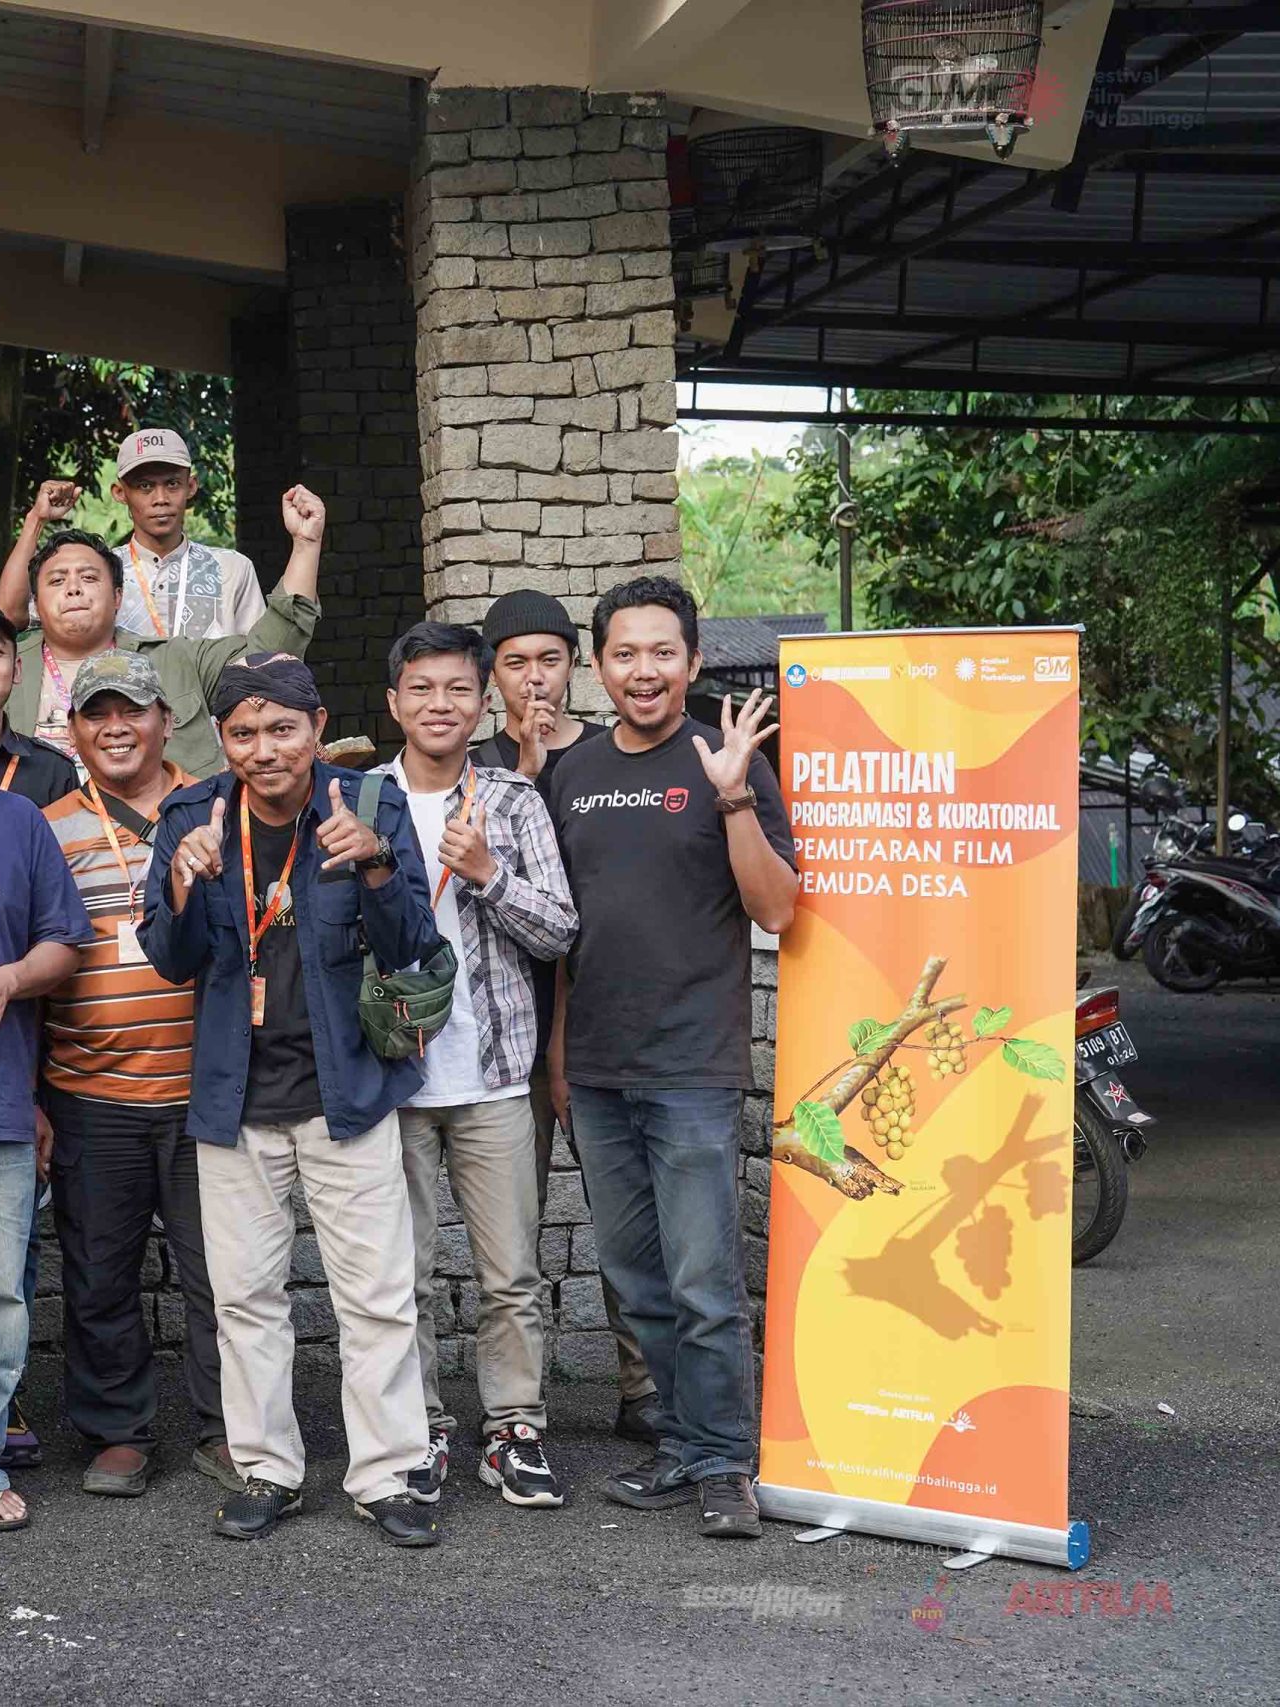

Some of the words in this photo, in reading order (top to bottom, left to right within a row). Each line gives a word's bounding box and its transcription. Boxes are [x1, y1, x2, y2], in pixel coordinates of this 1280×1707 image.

[143, 436, 165, 447] 501
[908, 663, 937, 678] lpdp
[792, 751, 955, 794] PELATIHAN
[570, 788, 663, 814] symbolic
[791, 801, 912, 828] PROGRAMASI
[917, 802, 932, 828] &
[938, 803, 1060, 830] KURATORIAL
[793, 838, 942, 863] PEMUTARAN
[953, 841, 1013, 864] FILM
[902, 873, 968, 897] DESA
[1078, 1036, 1105, 1058] 5109
[1109, 1026, 1125, 1045] BT
[806, 1458, 997, 1495] www.festivalfilmpurbalingga.id
